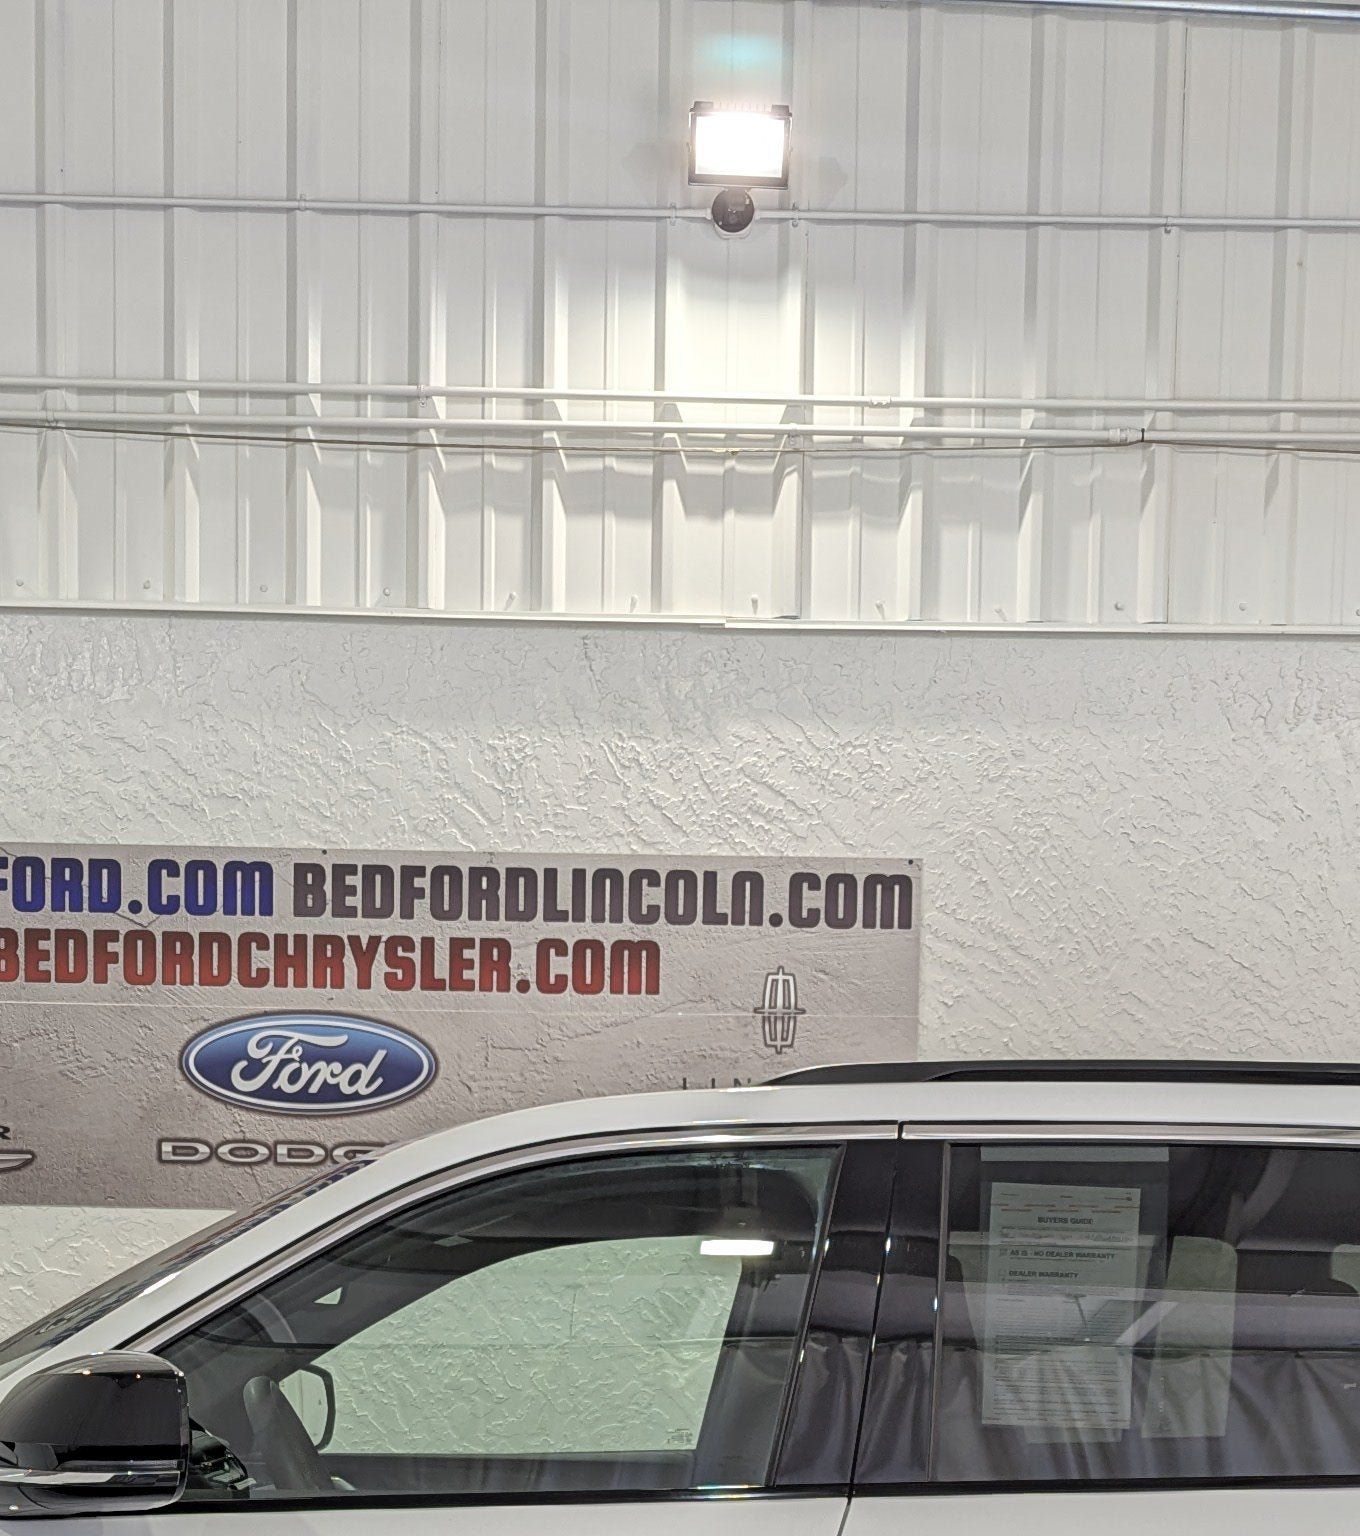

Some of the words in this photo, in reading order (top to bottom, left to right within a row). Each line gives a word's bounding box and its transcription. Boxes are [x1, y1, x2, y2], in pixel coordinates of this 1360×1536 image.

[293, 863, 914, 930] BEDFORDLINCOLN.COM
[230, 1030, 388, 1096] Ford
[159, 1140, 385, 1164] DODG
